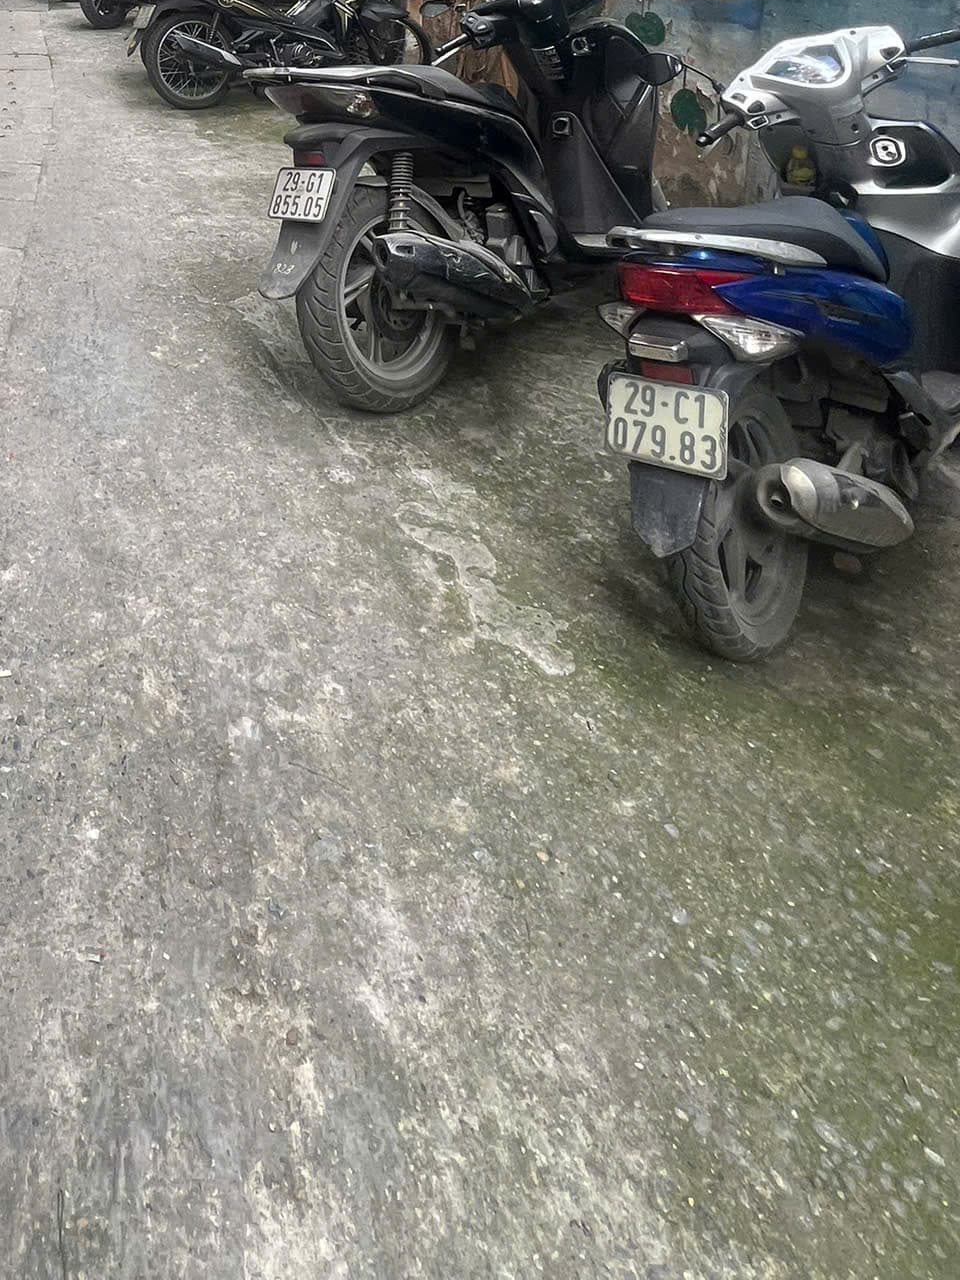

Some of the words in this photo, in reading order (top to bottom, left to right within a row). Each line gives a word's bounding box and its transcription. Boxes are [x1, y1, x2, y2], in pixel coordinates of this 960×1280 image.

[282, 172, 324, 194] 29-G1
[272, 195, 324, 218] 855.05
[624, 381, 705, 428] 29-C1
[613, 417, 717, 470] 079.83
